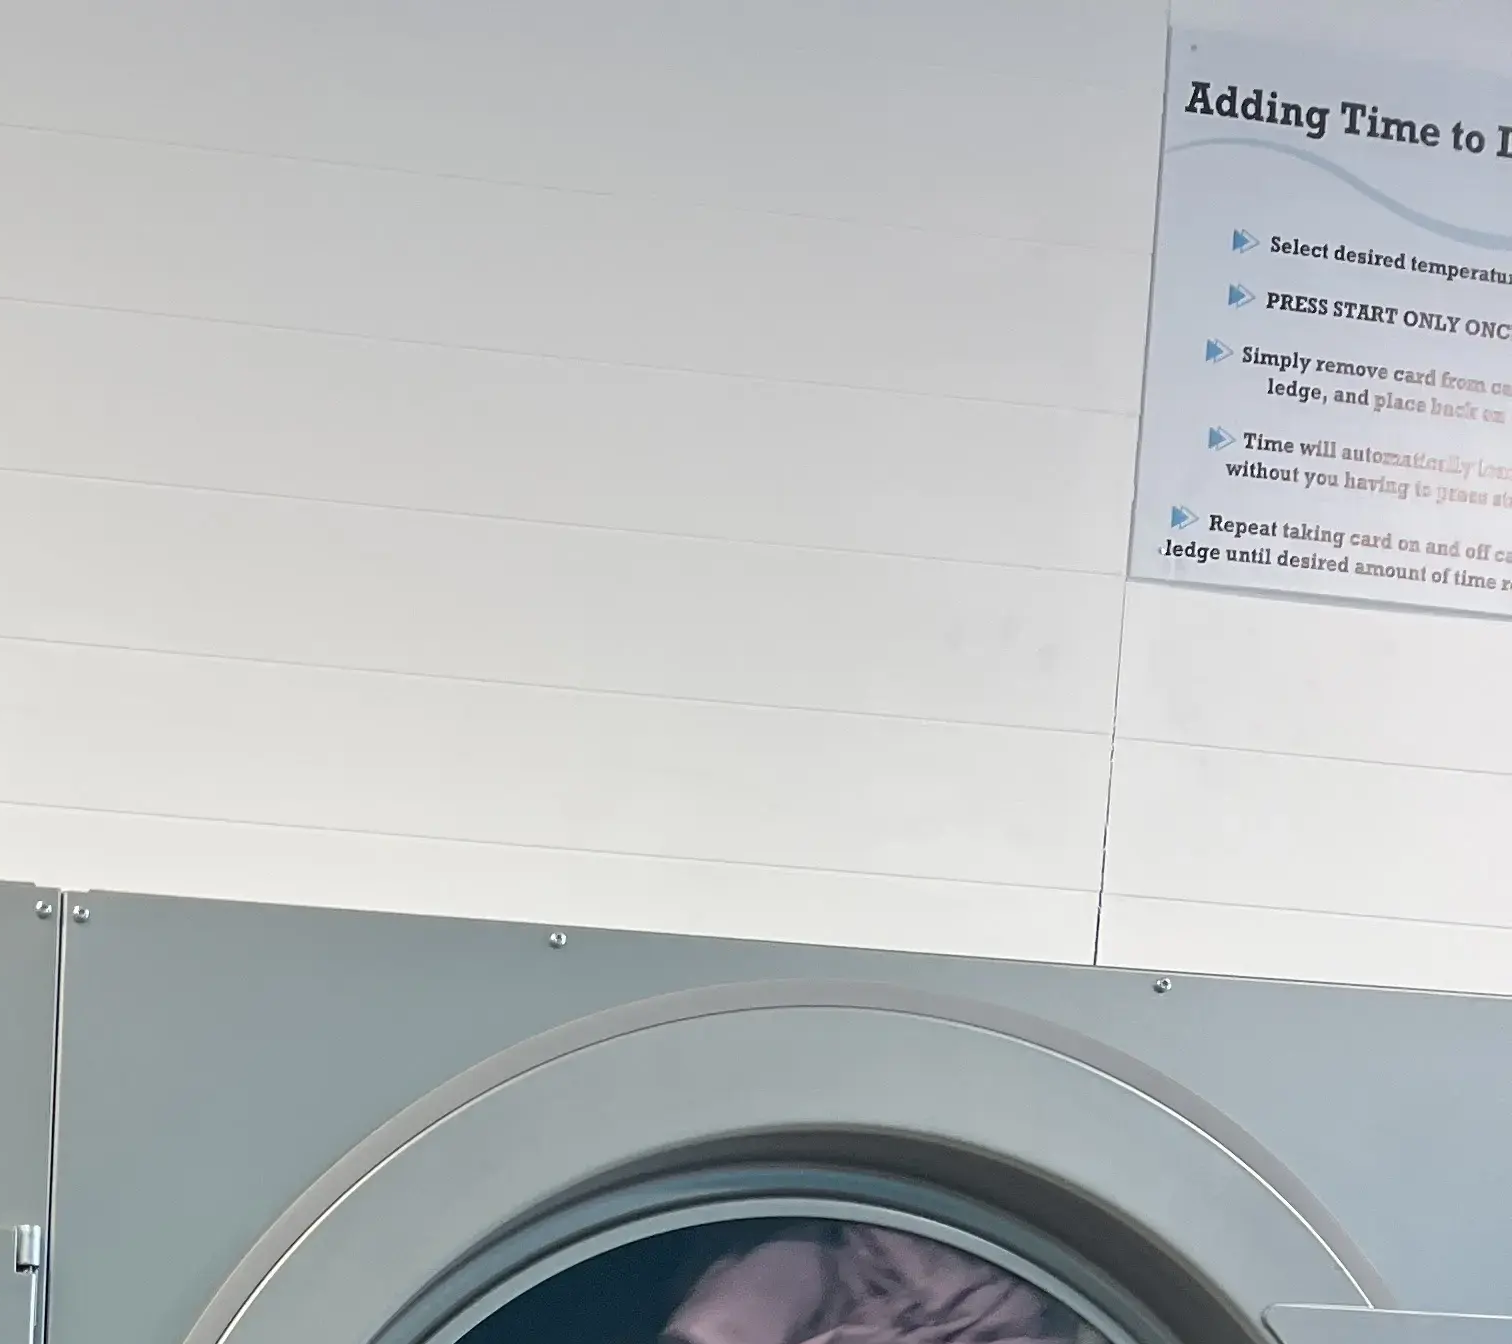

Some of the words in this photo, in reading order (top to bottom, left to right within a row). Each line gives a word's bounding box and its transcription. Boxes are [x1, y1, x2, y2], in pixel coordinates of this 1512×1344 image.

[1184, 81, 1330, 139] Adding
[1341, 101, 1440, 147] Time
[1451, 120, 1485, 154] to
[1271, 236, 1328, 260] Select
[1334, 245, 1406, 271] desired
[1266, 291, 1328, 317] PRESS
[1333, 301, 1398, 325] START
[1403, 310, 1461, 334] ONLY
[1465, 319, 1512, 341] ONC
[1242, 345, 1312, 374] Simply
[1315, 358, 1388, 380] remove
[1394, 369, 1436, 387] card
[1441, 371, 1486, 393] from
[1267, 378, 1327, 405] ledge,
[1334, 389, 1369, 406] and
[1374, 392, 1426, 413] place
[1430, 398, 1479, 420] back
[1244, 432, 1294, 454] Time
[1300, 439, 1336, 458] will
[1226, 460, 1299, 483] without
[1305, 471, 1339, 489] you
[1344, 471, 1409, 500] having
[1209, 514, 1277, 538] Repeat
[1283, 522, 1345, 548] taking
[1350, 532, 1393, 551] card
[1398, 538, 1420, 553] on
[1425, 541, 1460, 559] and
[1465, 543, 1492, 562] off
[1165, 539, 1220, 563] ledge
[1226, 548, 1271, 565] until
[1277, 550, 1348, 574] desired
[1354, 561, 1427, 582] amount
[1431, 567, 1452, 585] of
[1454, 569, 1496, 590] time
